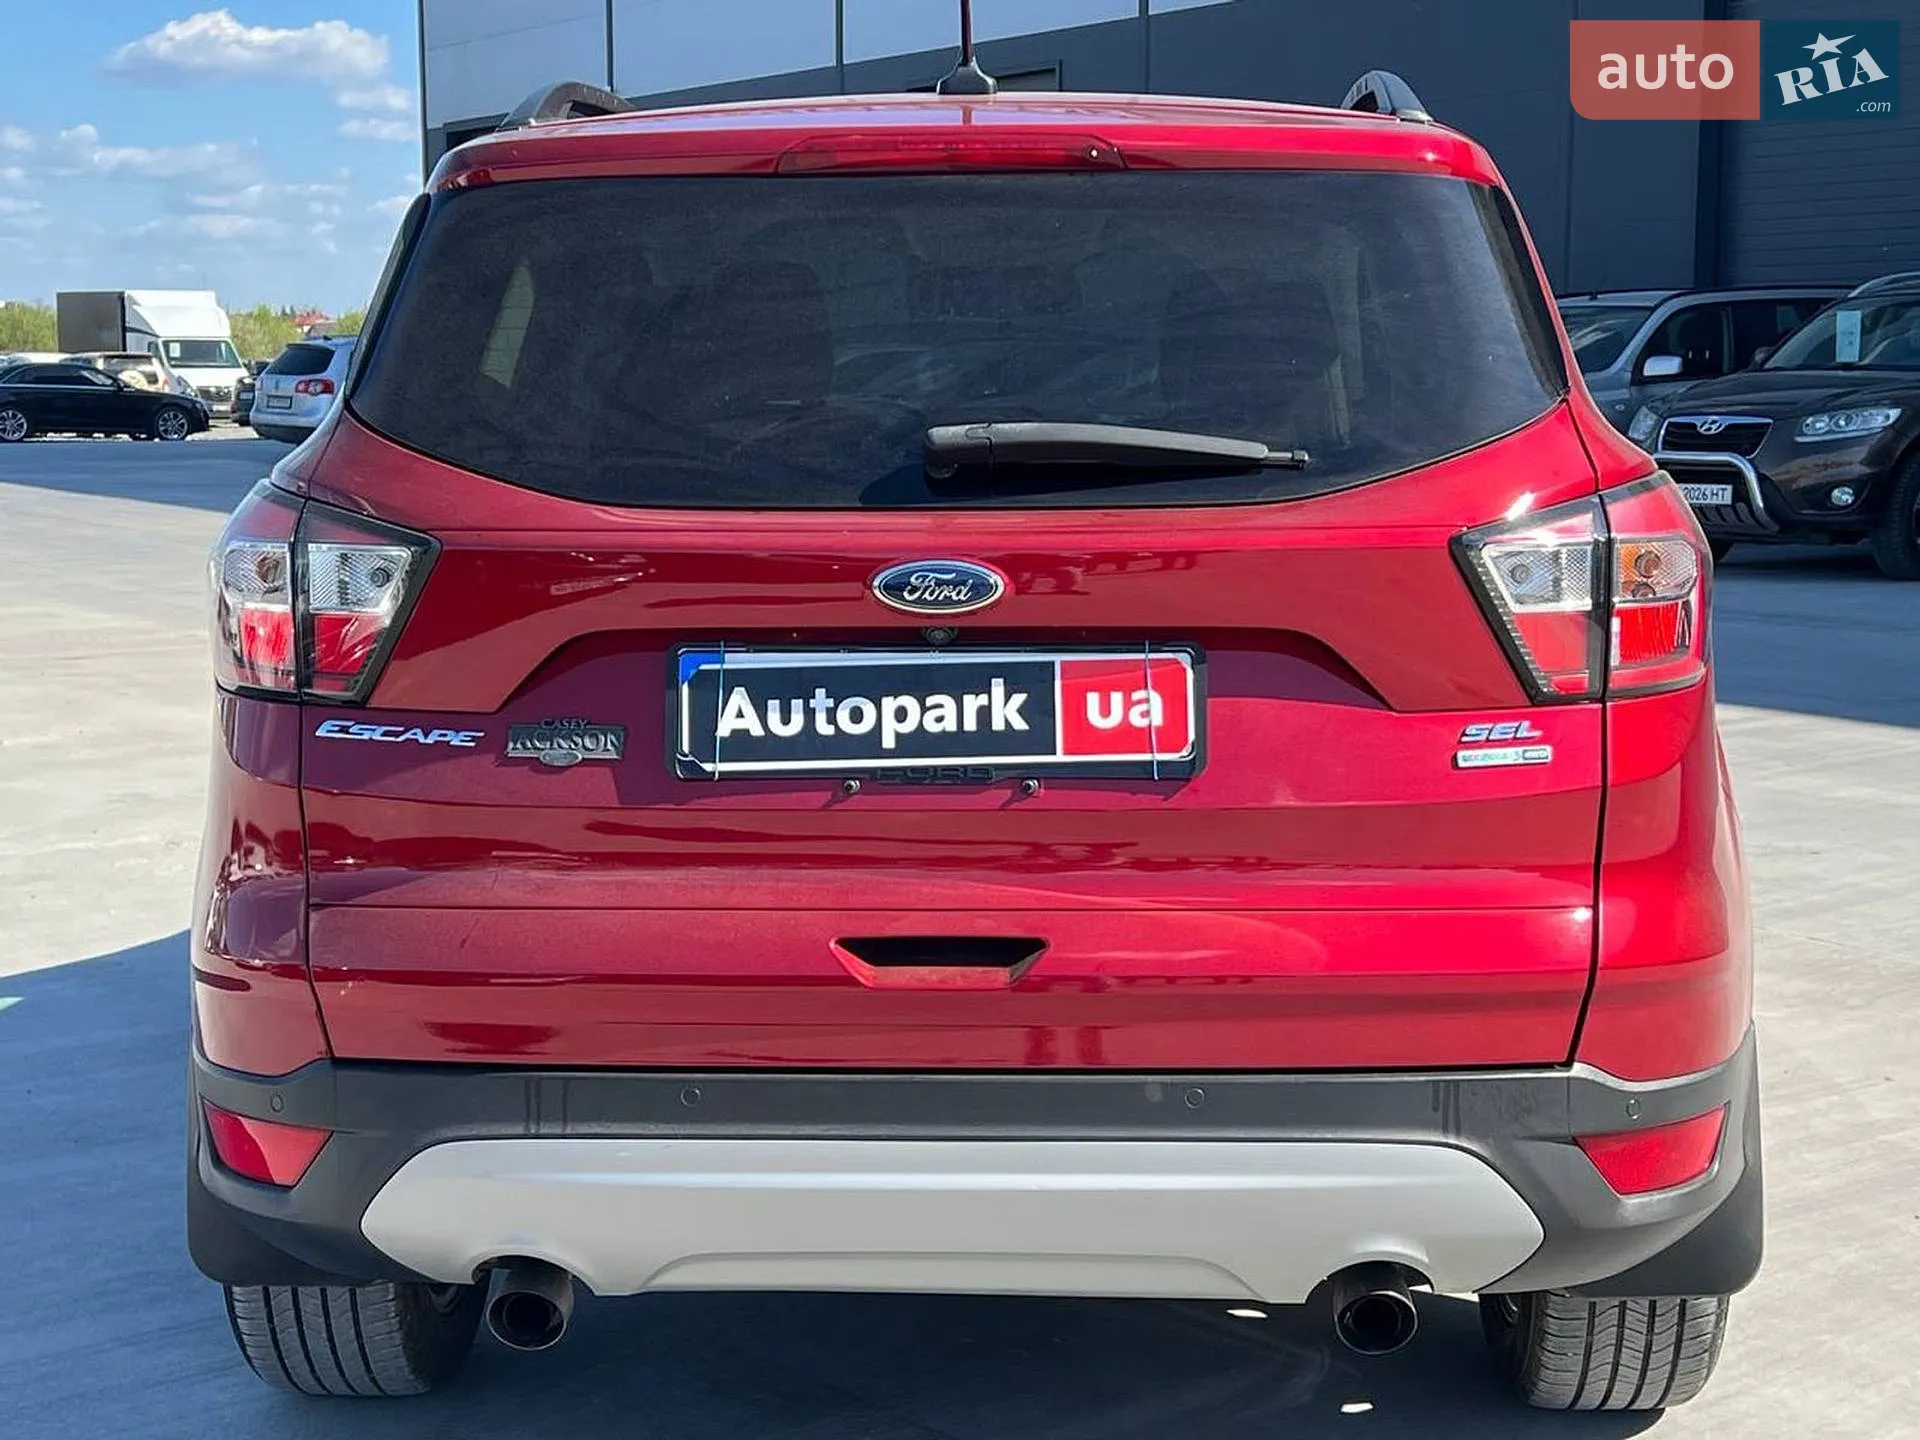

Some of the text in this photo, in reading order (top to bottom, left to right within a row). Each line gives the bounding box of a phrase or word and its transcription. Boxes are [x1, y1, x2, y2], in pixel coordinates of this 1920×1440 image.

[903, 571, 973, 601] Ford
[716, 677, 1029, 749] Autopark
[1085, 689, 1164, 728] ua
[315, 720, 485, 747] ESCAPE
[1459, 720, 1543, 742] SEL
